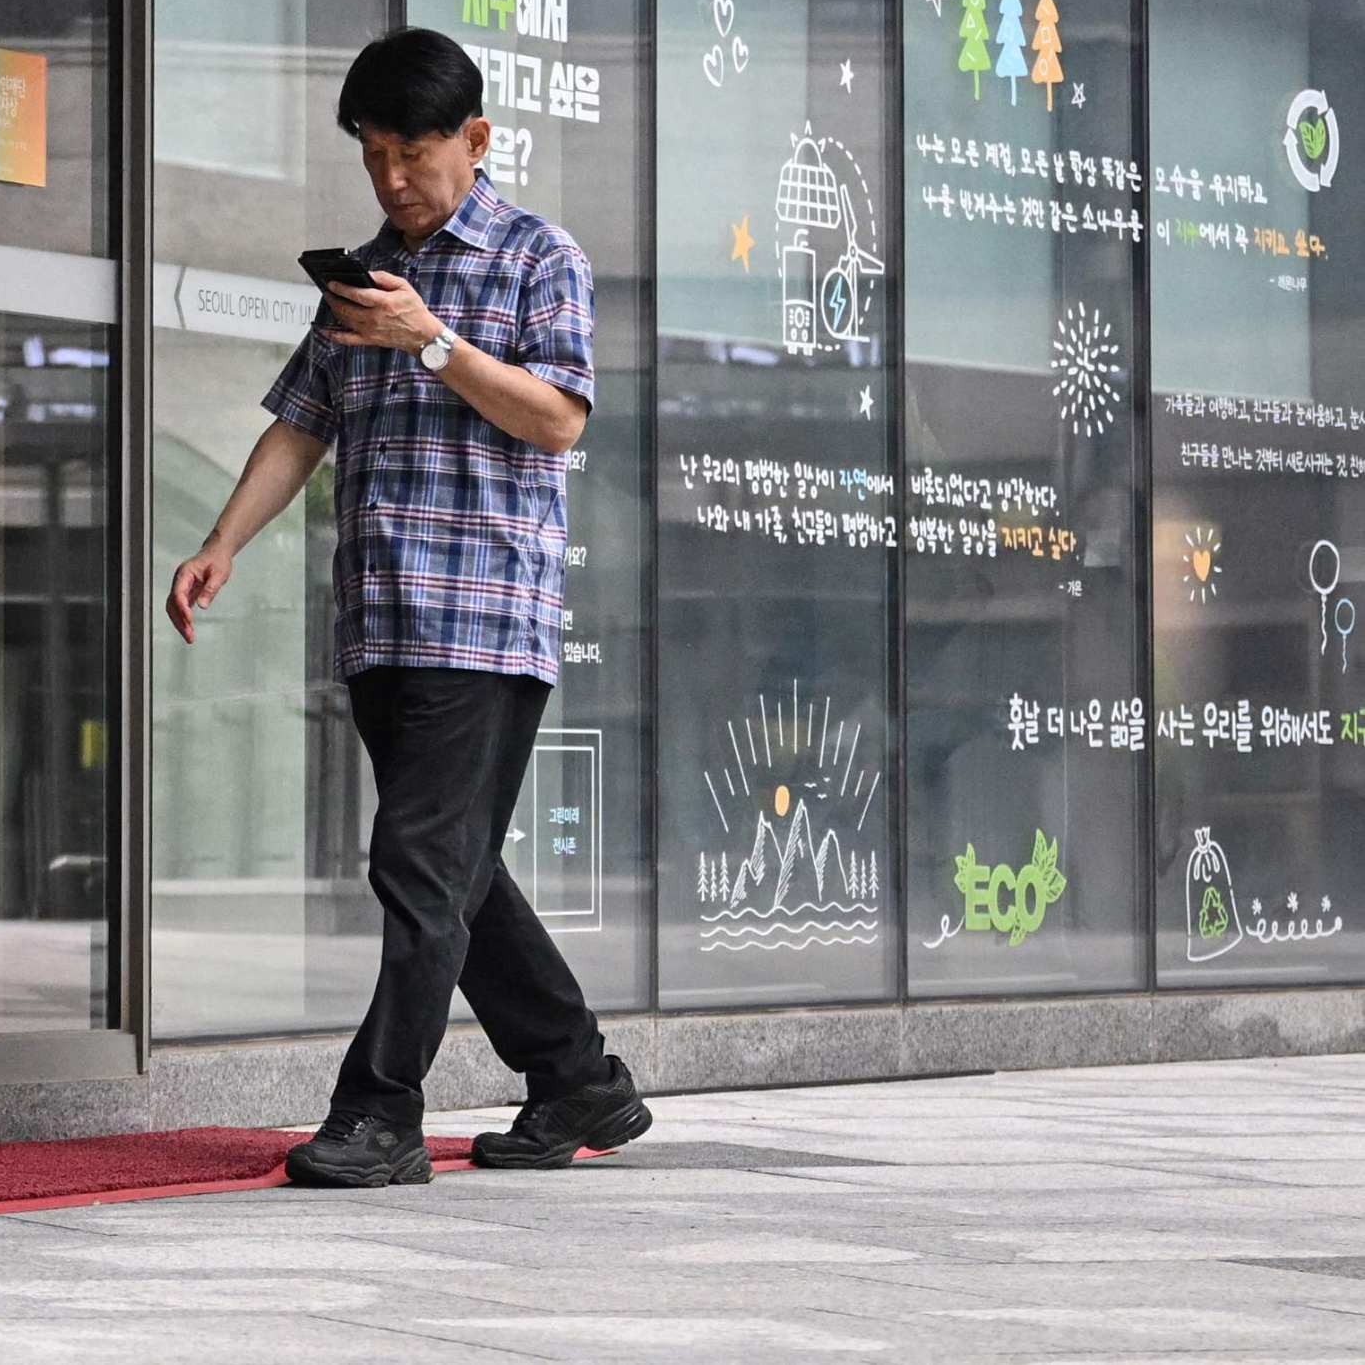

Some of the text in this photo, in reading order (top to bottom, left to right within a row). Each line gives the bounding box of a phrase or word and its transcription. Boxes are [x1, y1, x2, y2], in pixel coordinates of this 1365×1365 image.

[549, 60, 600, 124] 싶은
[485, 125, 533, 187] 은?
[916, 133, 946, 164] 나는
[950, 137, 980, 168] 모든
[984, 141, 1016, 177] 계절,
[1021, 147, 1050, 179] 모든
[1069, 150, 1097, 187] 항상
[1101, 156, 1143, 192] 똑같은
[1155, 164, 1204, 201] 모습을
[1209, 173, 1268, 207] 유지하고
[922, 183, 955, 218] 나를
[1021, 196, 1046, 229] 것만
[1049, 200, 1078, 233] 같은
[1082, 202, 1144, 243] 소나무를
[1156, 218, 1170, 246] 이
[1235, 223, 1249, 255] 꼭
[1253, 227, 1291, 256] 지키고
[198, 289, 236, 316] SEOUL
[238, 295, 269, 320] OPEN
[272, 300, 298, 324] CITY
[680, 454, 1060, 517] 난 우리의 평범한 일상이 자연에서 비롯되었다고 생각한다.
[1181, 442, 1219, 468] 친구들을
[1222, 444, 1254, 471] 만나는
[697, 504, 1081, 561] 나와 내 가족, 친구들의 평범하고 행복한 일상을 지키고 싶다.
[564, 642, 603, 665] 있습니다.
[1008, 693, 1040, 751] 훗날
[1047, 706, 1064, 737] 더
[1070, 699, 1104, 748] 나은
[1110, 697, 1145, 752] 삶을
[1157, 703, 1195, 747] 사는
[1202, 699, 1253, 753] 우리를
[1260, 705, 1334, 747] 위해서도
[965, 863, 1047, 933] ECO
